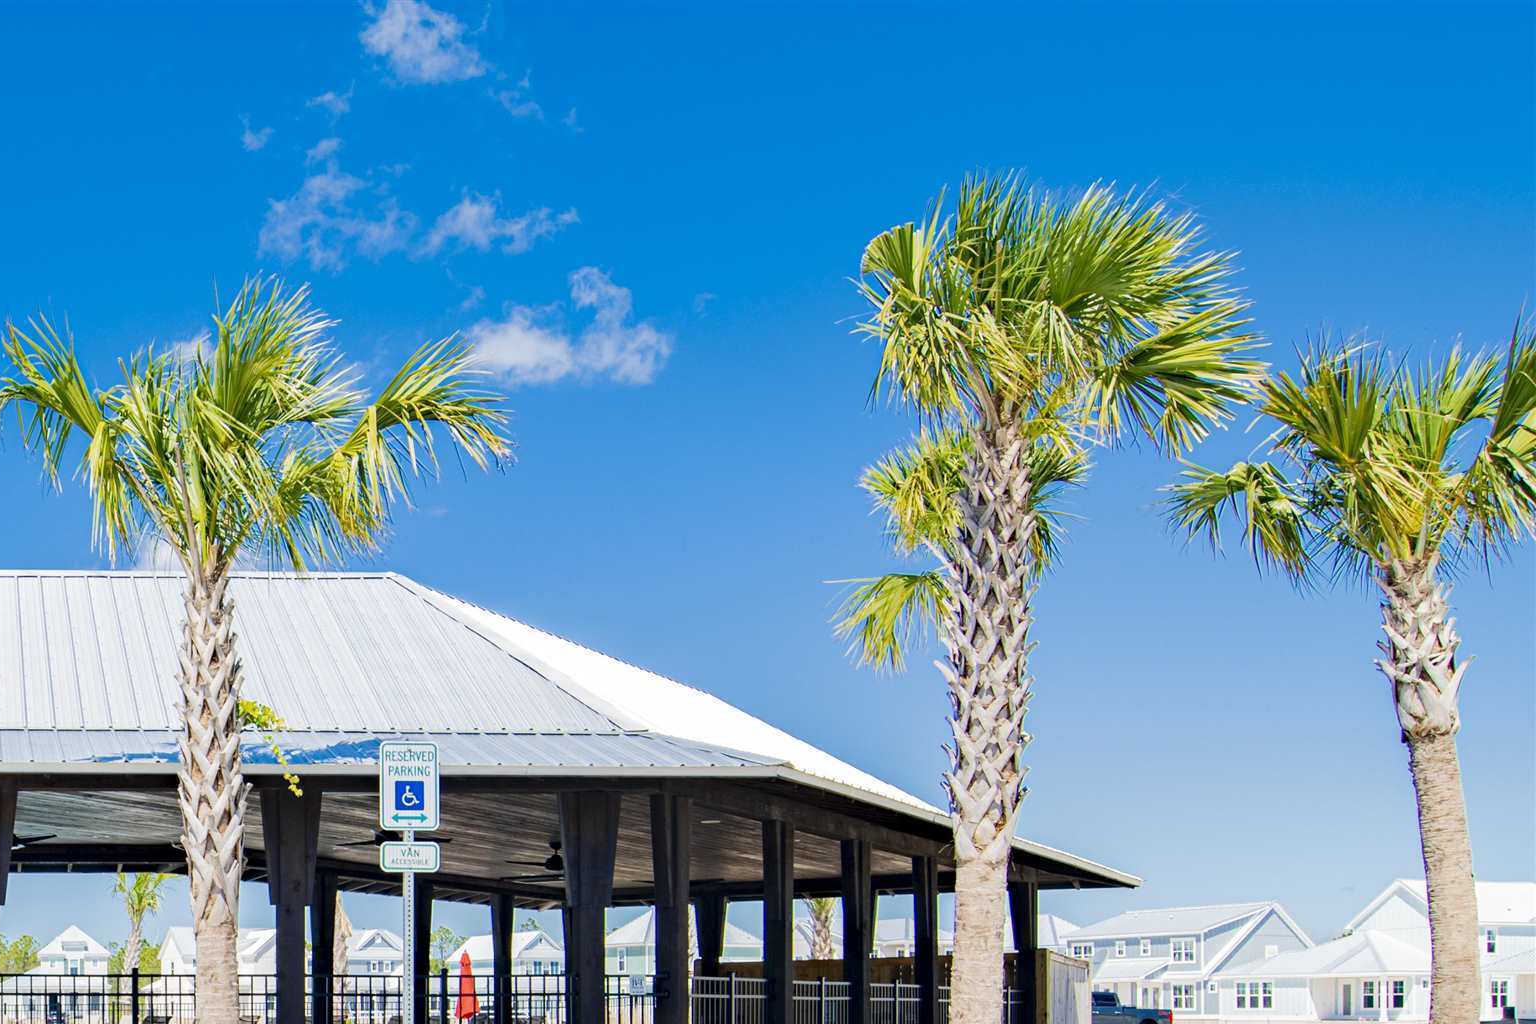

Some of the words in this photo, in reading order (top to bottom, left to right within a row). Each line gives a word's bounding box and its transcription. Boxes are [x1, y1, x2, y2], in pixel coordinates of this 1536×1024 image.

[385, 751, 434, 762] RESERVED
[388, 766, 431, 777] PARKING
[400, 848, 420, 857] VAN
